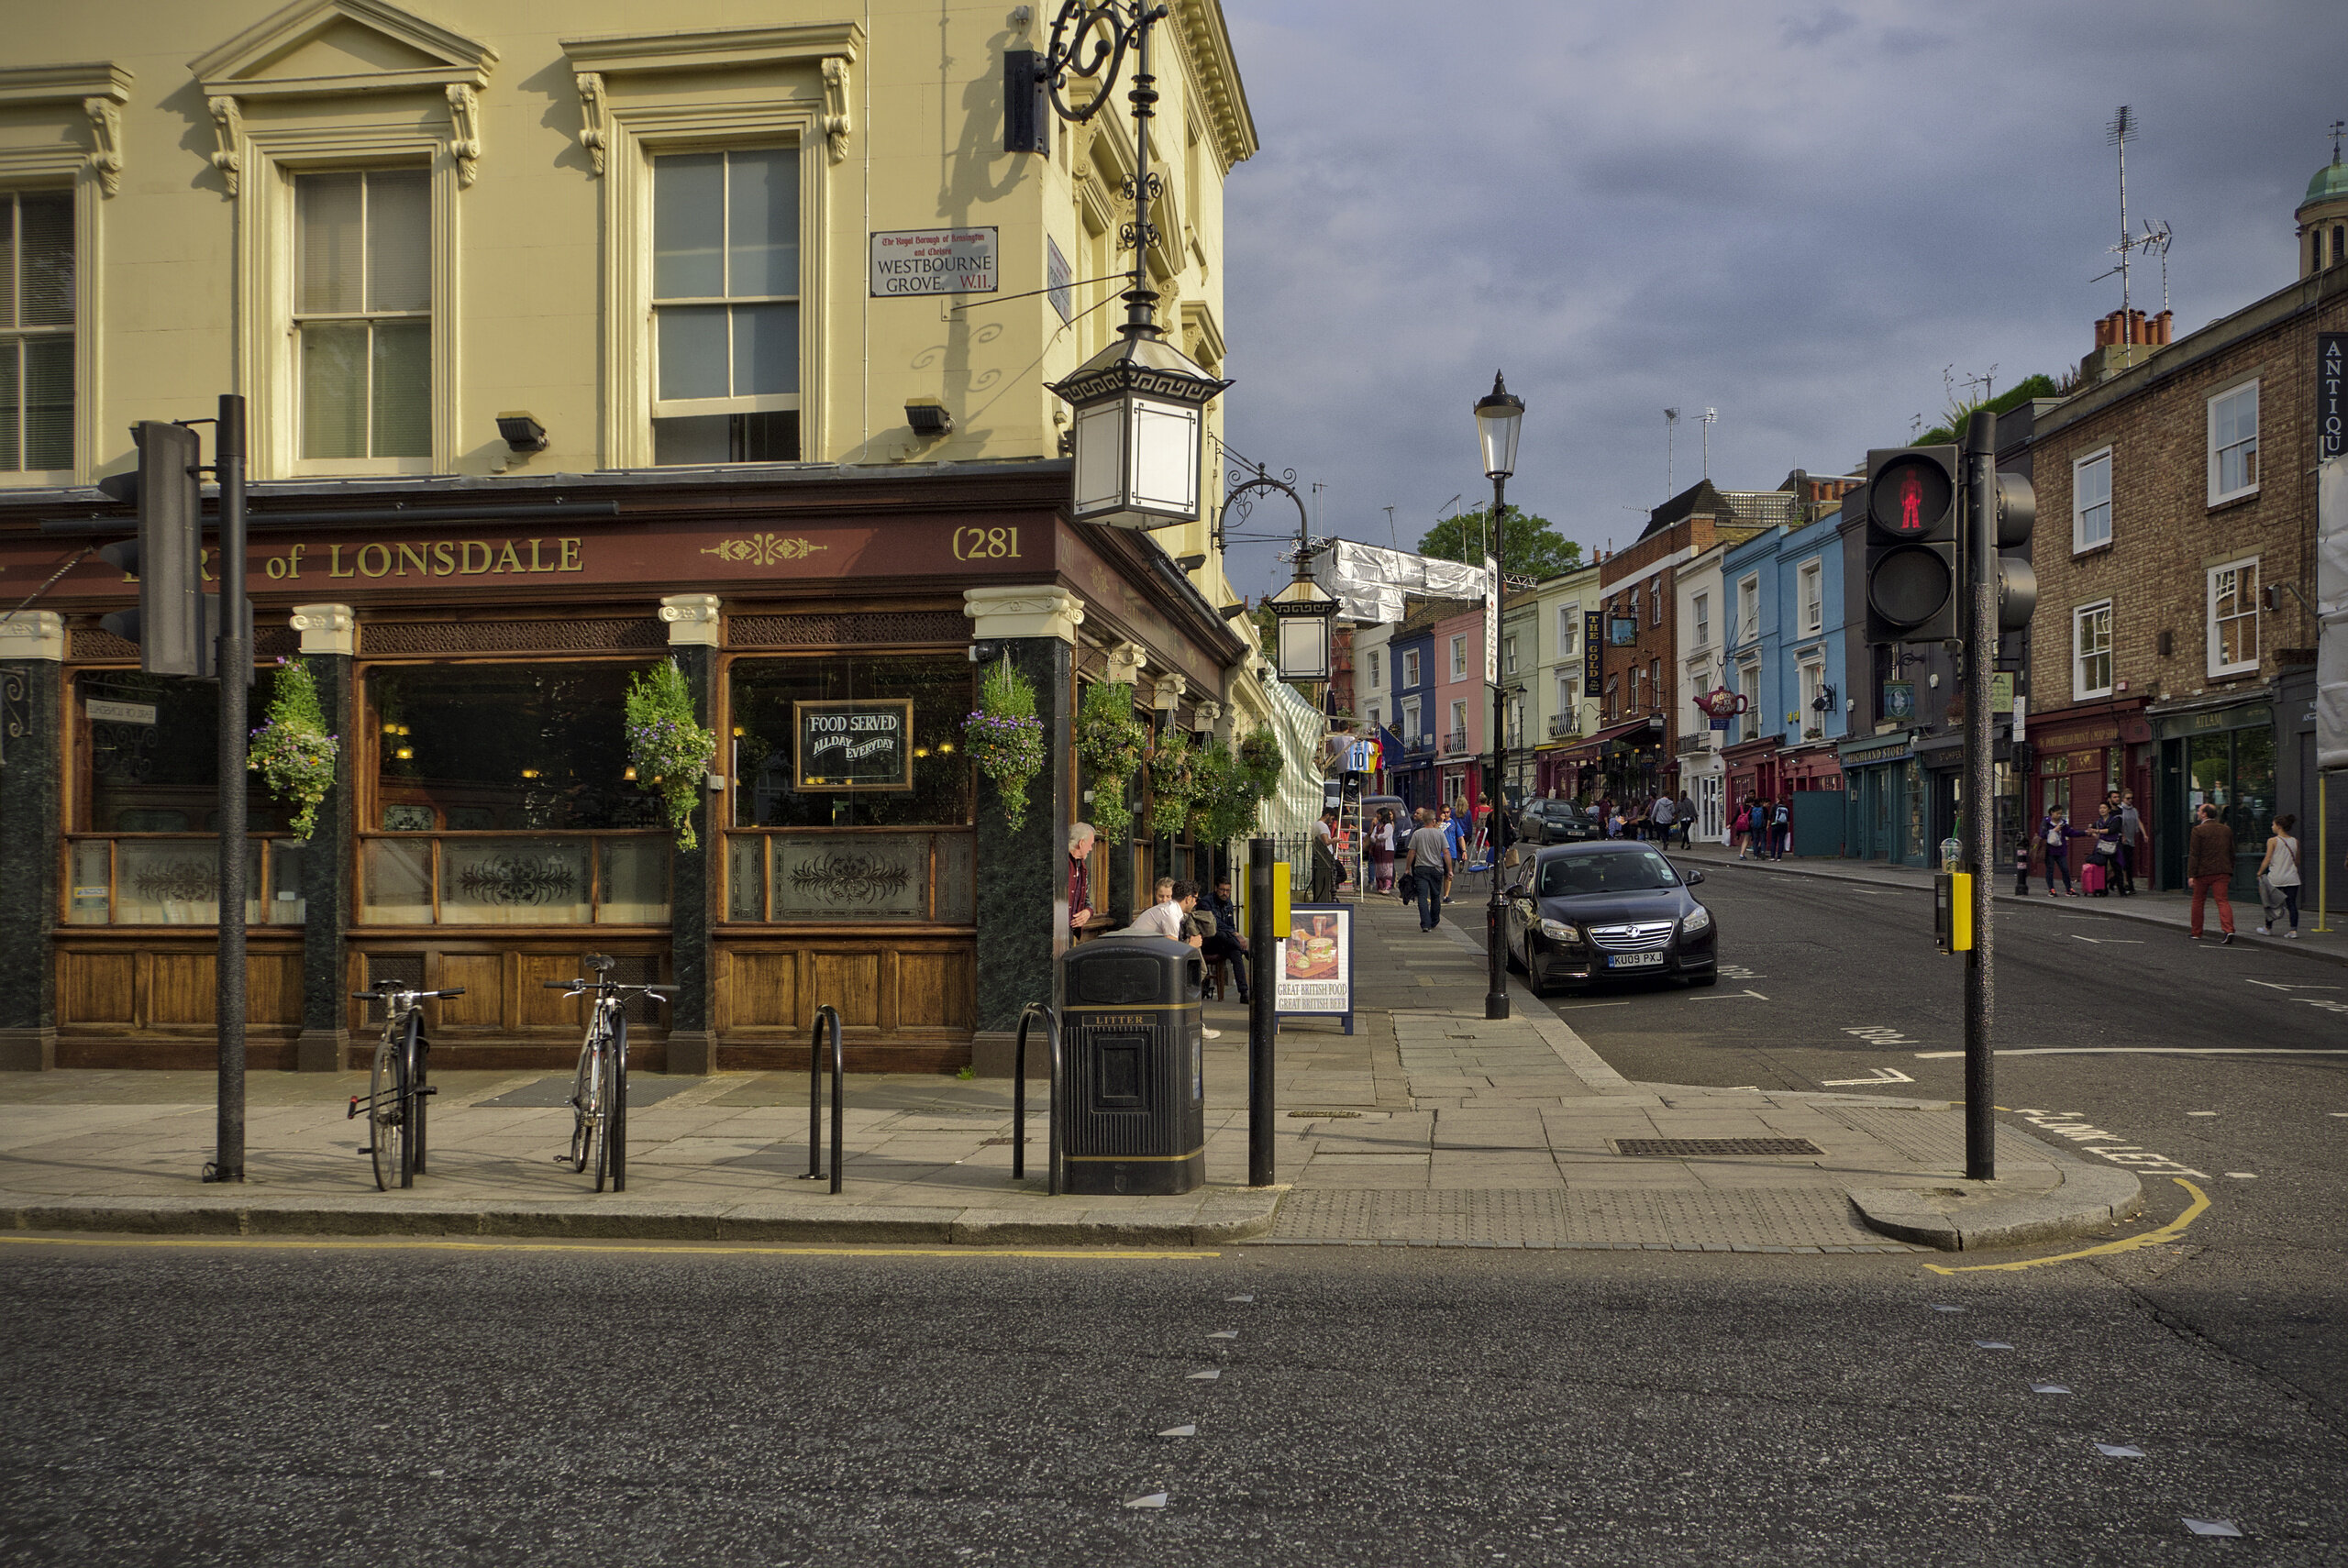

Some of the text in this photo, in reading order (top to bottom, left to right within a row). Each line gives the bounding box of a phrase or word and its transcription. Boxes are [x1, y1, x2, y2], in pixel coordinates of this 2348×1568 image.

[882, 233, 984, 247] The Royal Borough of Kensington
[928, 248, 951, 256] Chelsea
[878, 256, 991, 274] WESTBOURNE
[2326, 340, 2342, 458] ANTIQU
[952, 525, 1022, 561] (281
[266, 543, 305, 580] of
[329, 537, 584, 578] LONSDALE
[1588, 615, 1599, 640] THE
[1588, 645, 1599, 678] GOLD
[810, 715, 897, 732] FOOD SERVED
[845, 738, 894, 758] EVERYDAY
[1848, 745, 1905, 764] HIGHLAND STORE
[1354, 752, 1364, 767] 10
[1614, 952, 1662, 965] KU09 PXJ
[1278, 983, 1347, 995] GREAT BRITISH FOOD
[1279, 998, 1346, 1009] GREAT BRITISH BEER
[1096, 1016, 1144, 1024] LITTER
[2024, 1116, 2212, 1178] LOOK LEFT
